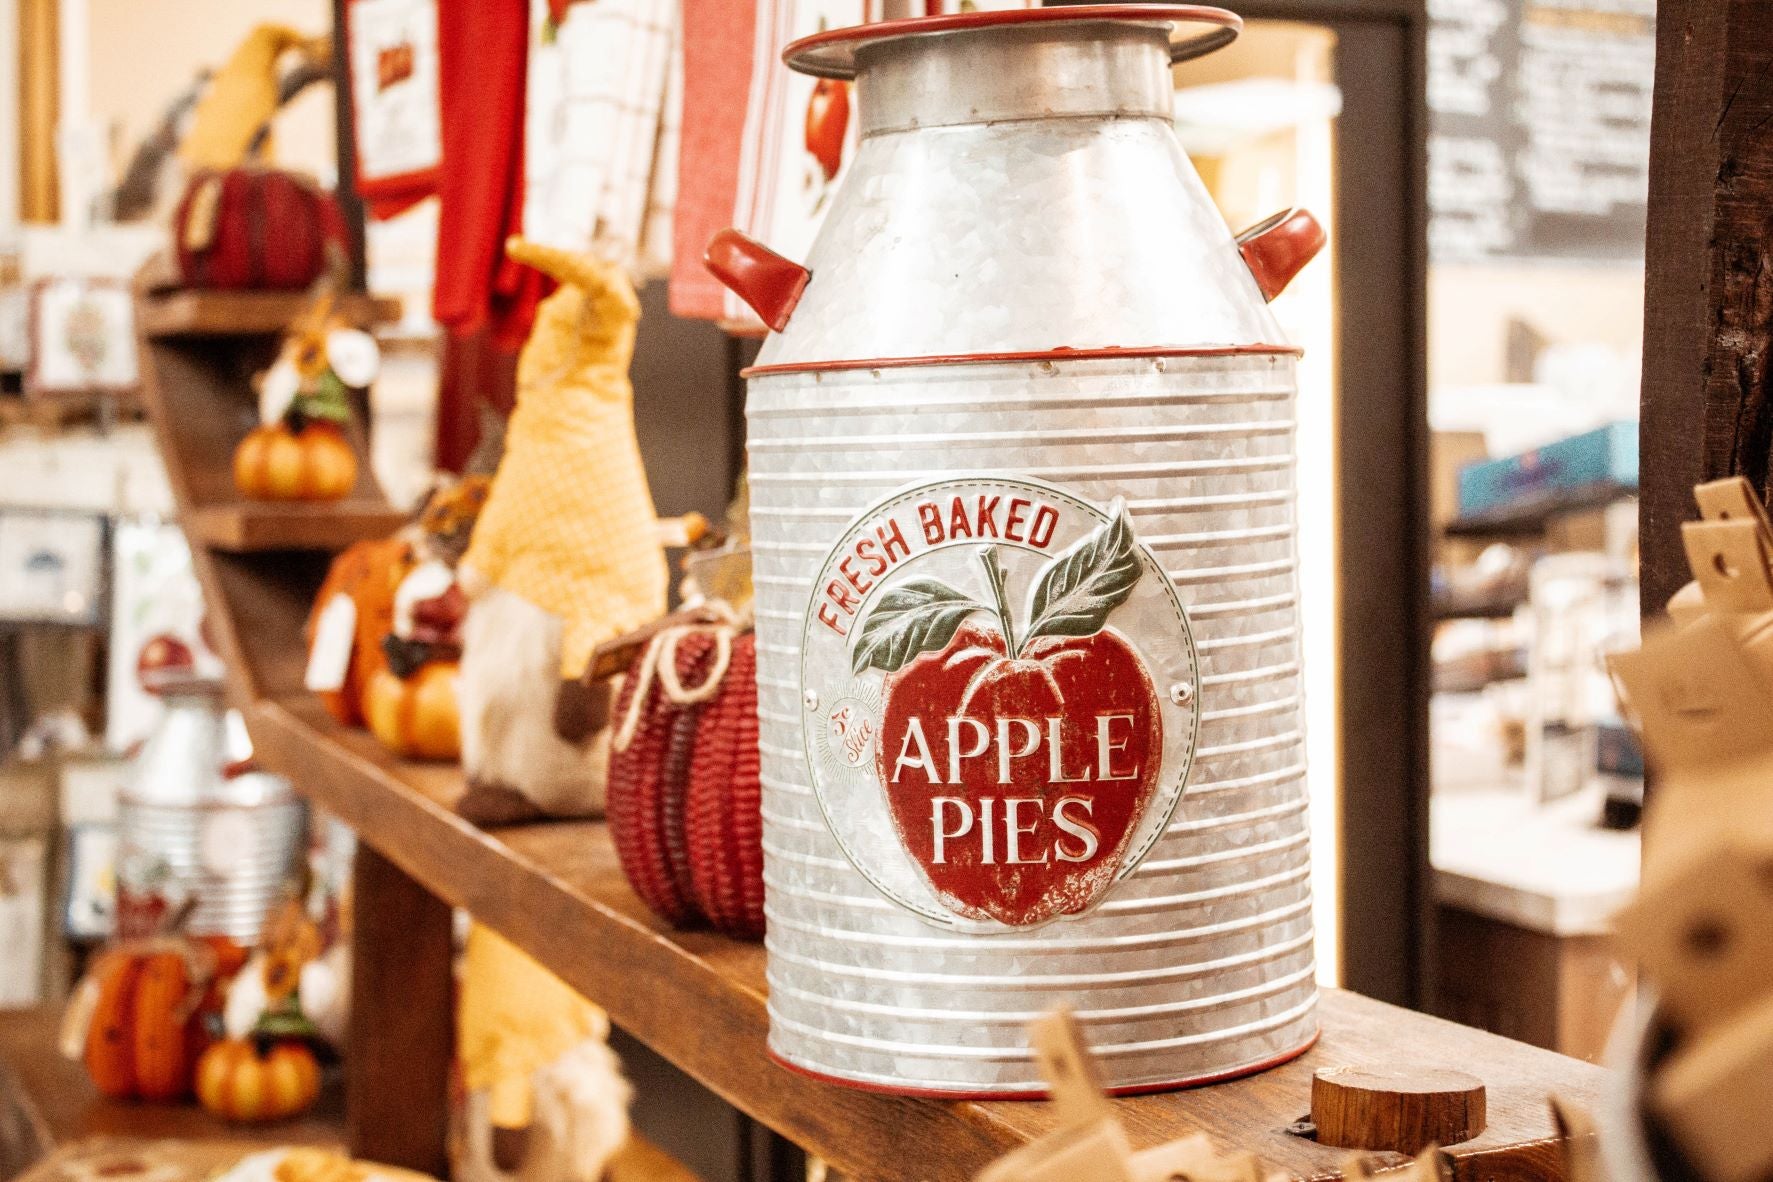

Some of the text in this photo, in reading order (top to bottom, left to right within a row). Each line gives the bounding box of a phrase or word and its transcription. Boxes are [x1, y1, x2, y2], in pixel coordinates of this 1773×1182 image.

[818, 495, 1060, 636] FRESH BAKED
[846, 719, 872, 763] Slice
[890, 715, 1138, 784] APPLE
[929, 797, 1098, 864] PIES
